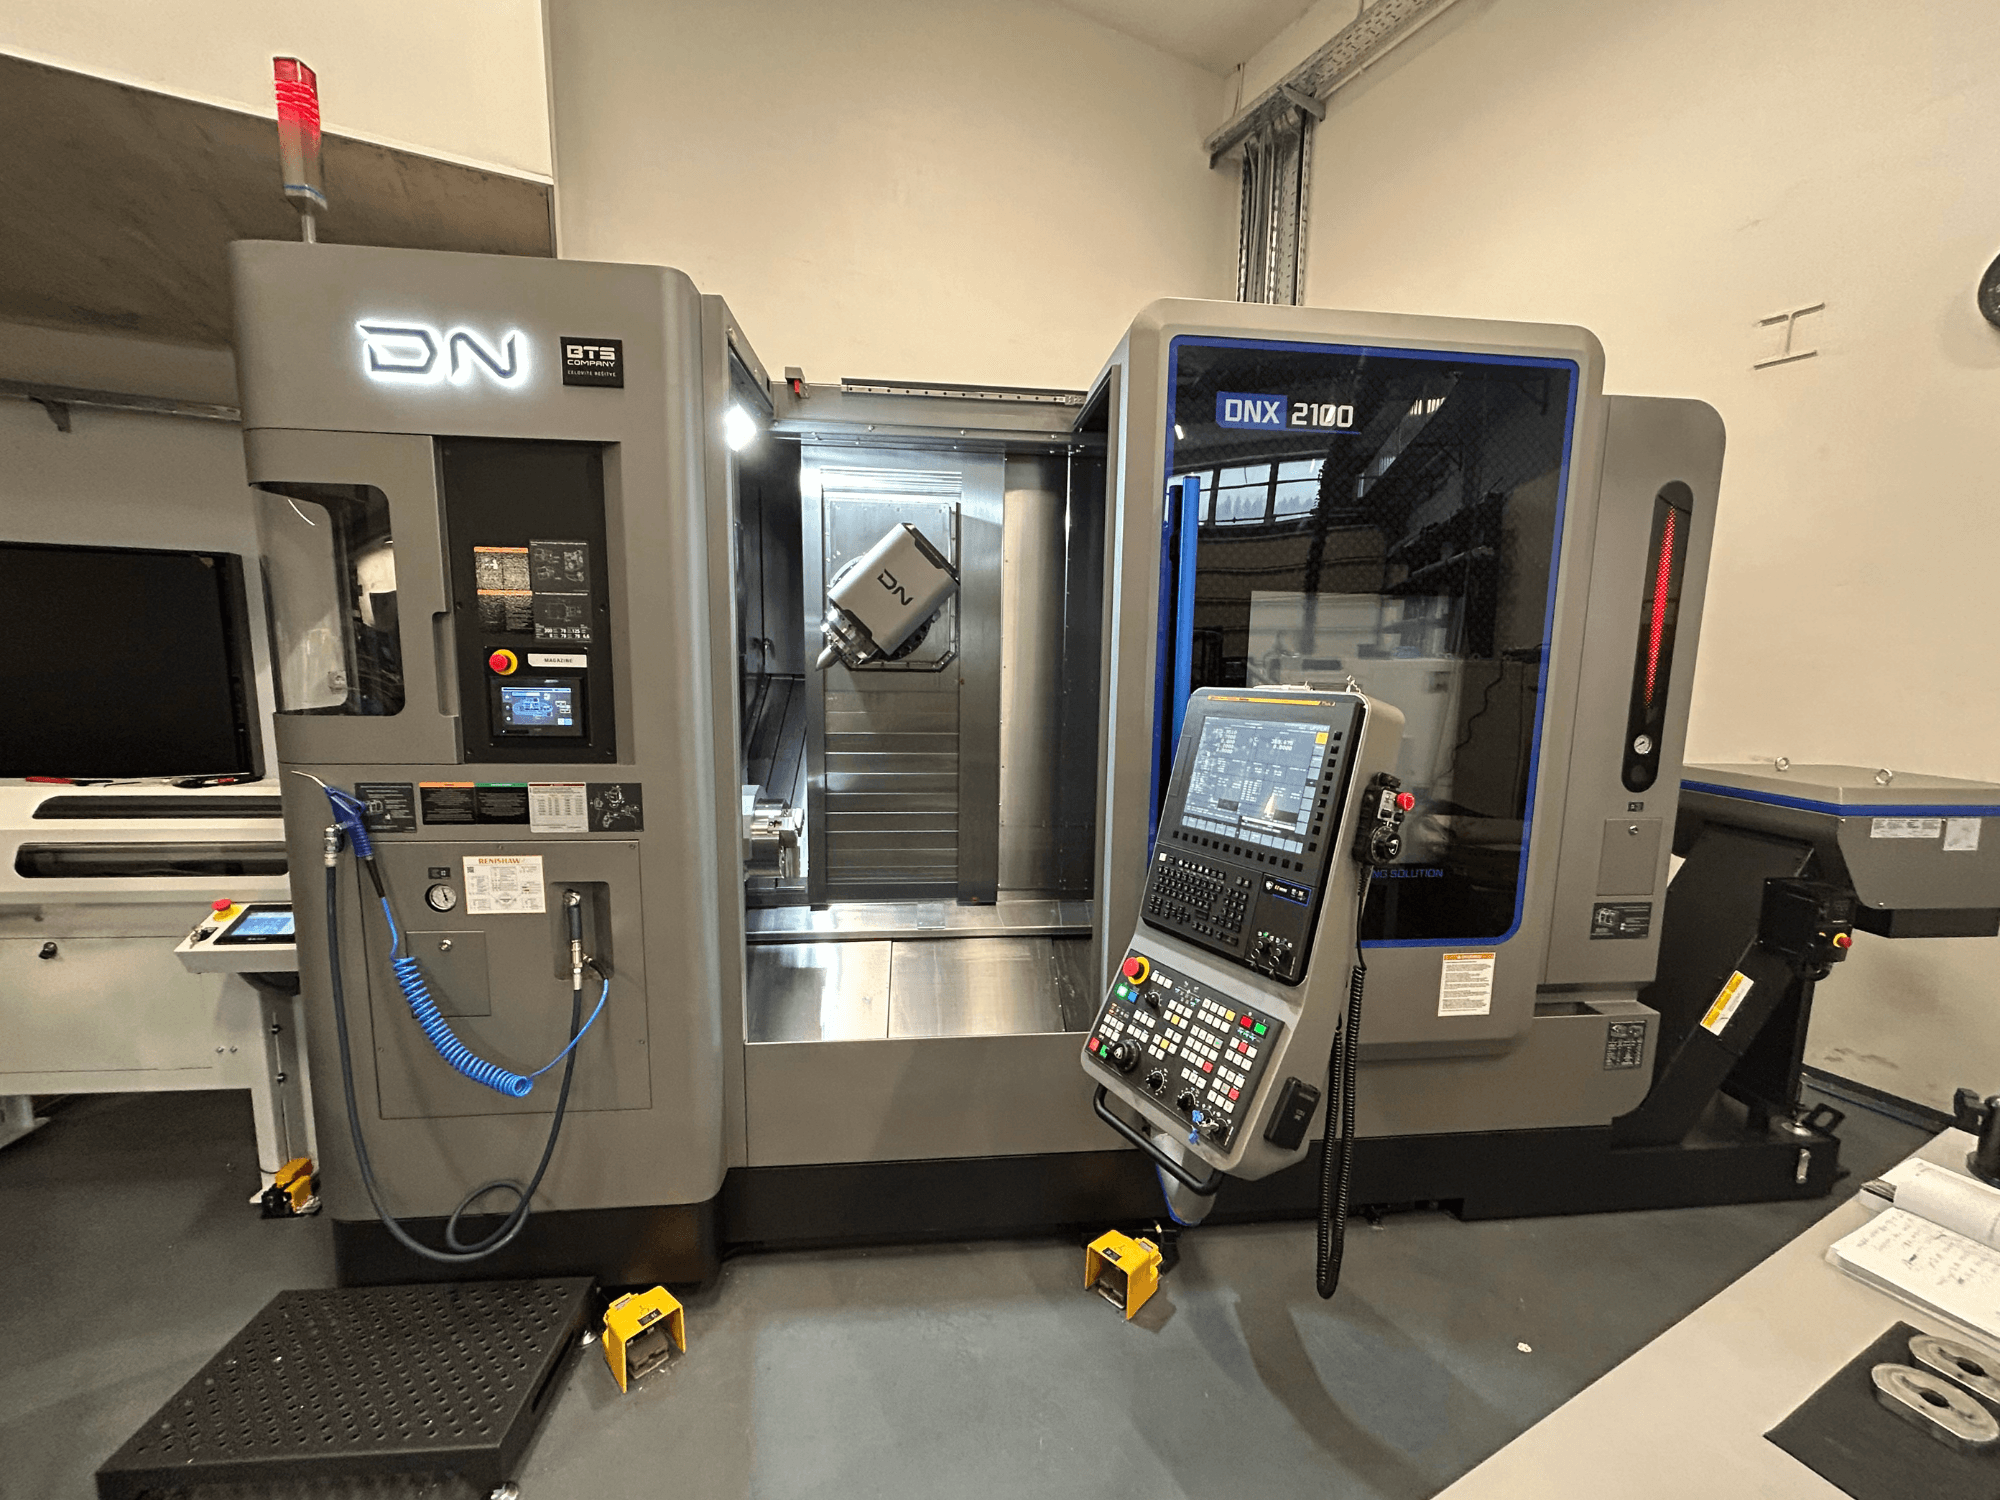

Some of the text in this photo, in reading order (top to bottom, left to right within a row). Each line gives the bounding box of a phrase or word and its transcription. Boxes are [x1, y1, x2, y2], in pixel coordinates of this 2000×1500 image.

[359, 324, 518, 380] DN
[566, 344, 616, 361] BTS
[567, 360, 616, 368] COMPANY
[1224, 398, 1354, 428] DNX 2100
[877, 568, 914, 606] DN
[1390, 869, 1444, 878] SOLUTION
